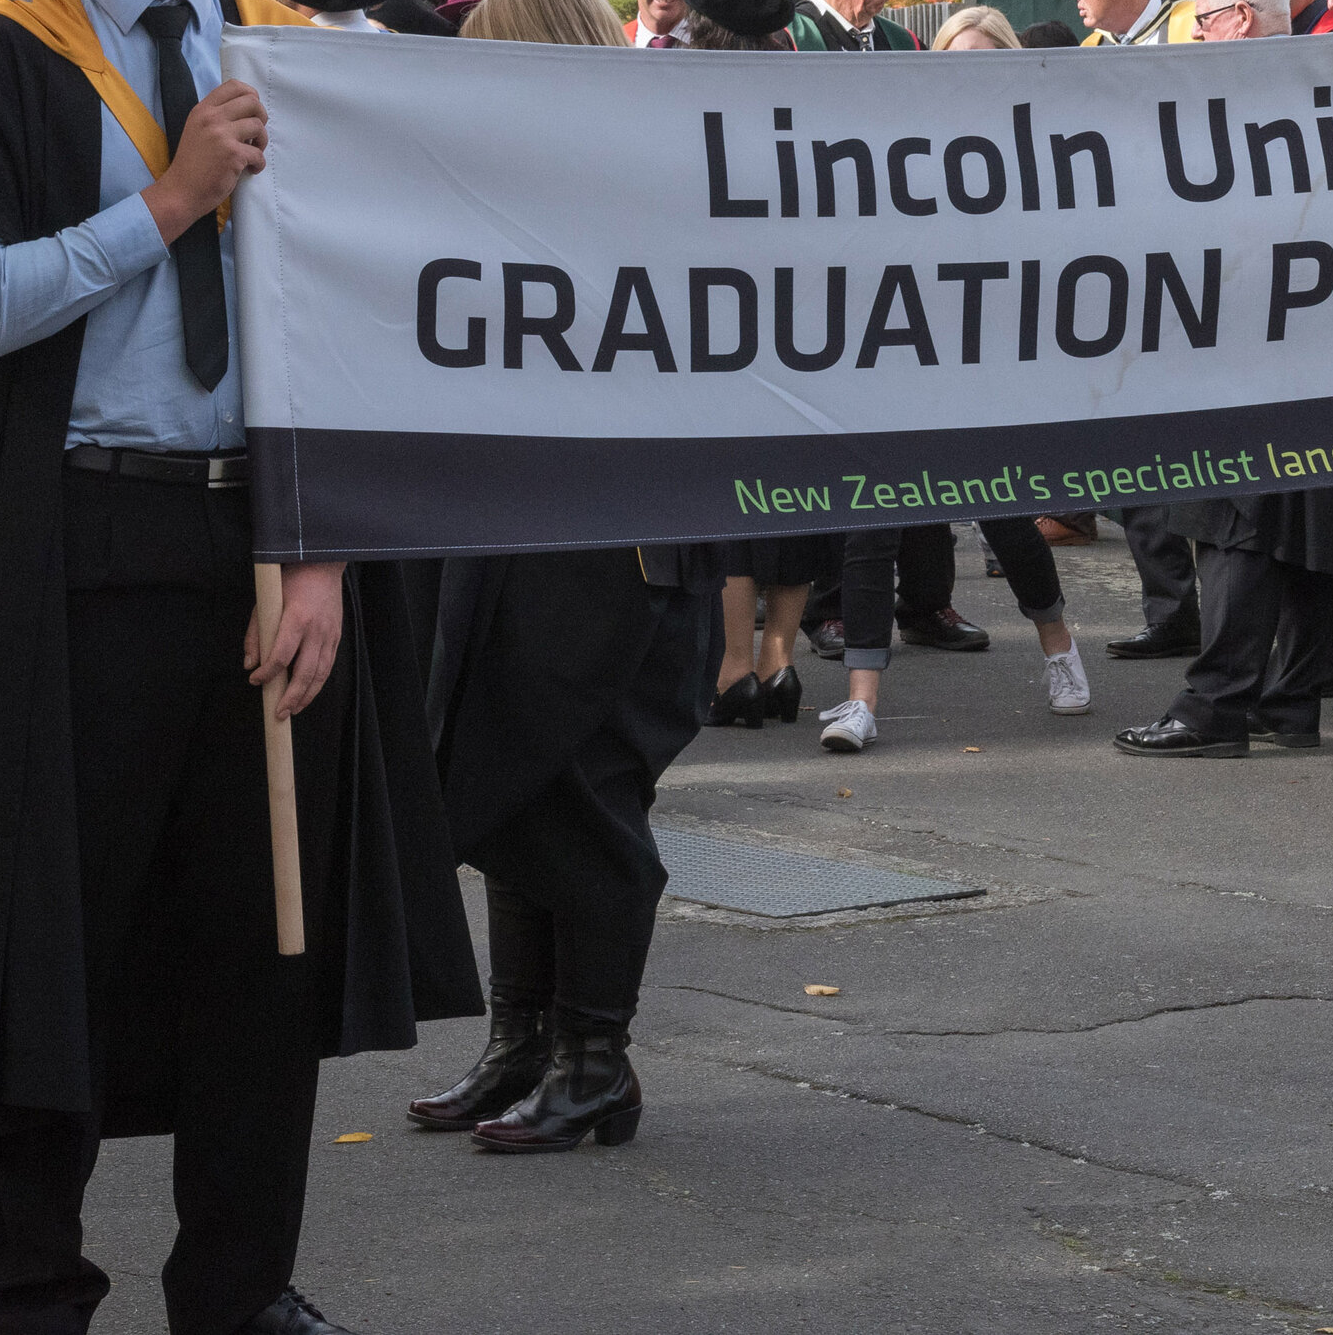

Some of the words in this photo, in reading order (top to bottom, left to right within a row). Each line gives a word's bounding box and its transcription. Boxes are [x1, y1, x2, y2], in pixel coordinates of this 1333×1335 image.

[703, 102, 1116, 219] Lincoln
[415, 248, 1223, 374] GRADUATION
[733, 478, 831, 514] New
[841, 466, 1051, 510] Zealand's
[1062, 449, 1260, 503] specialist
